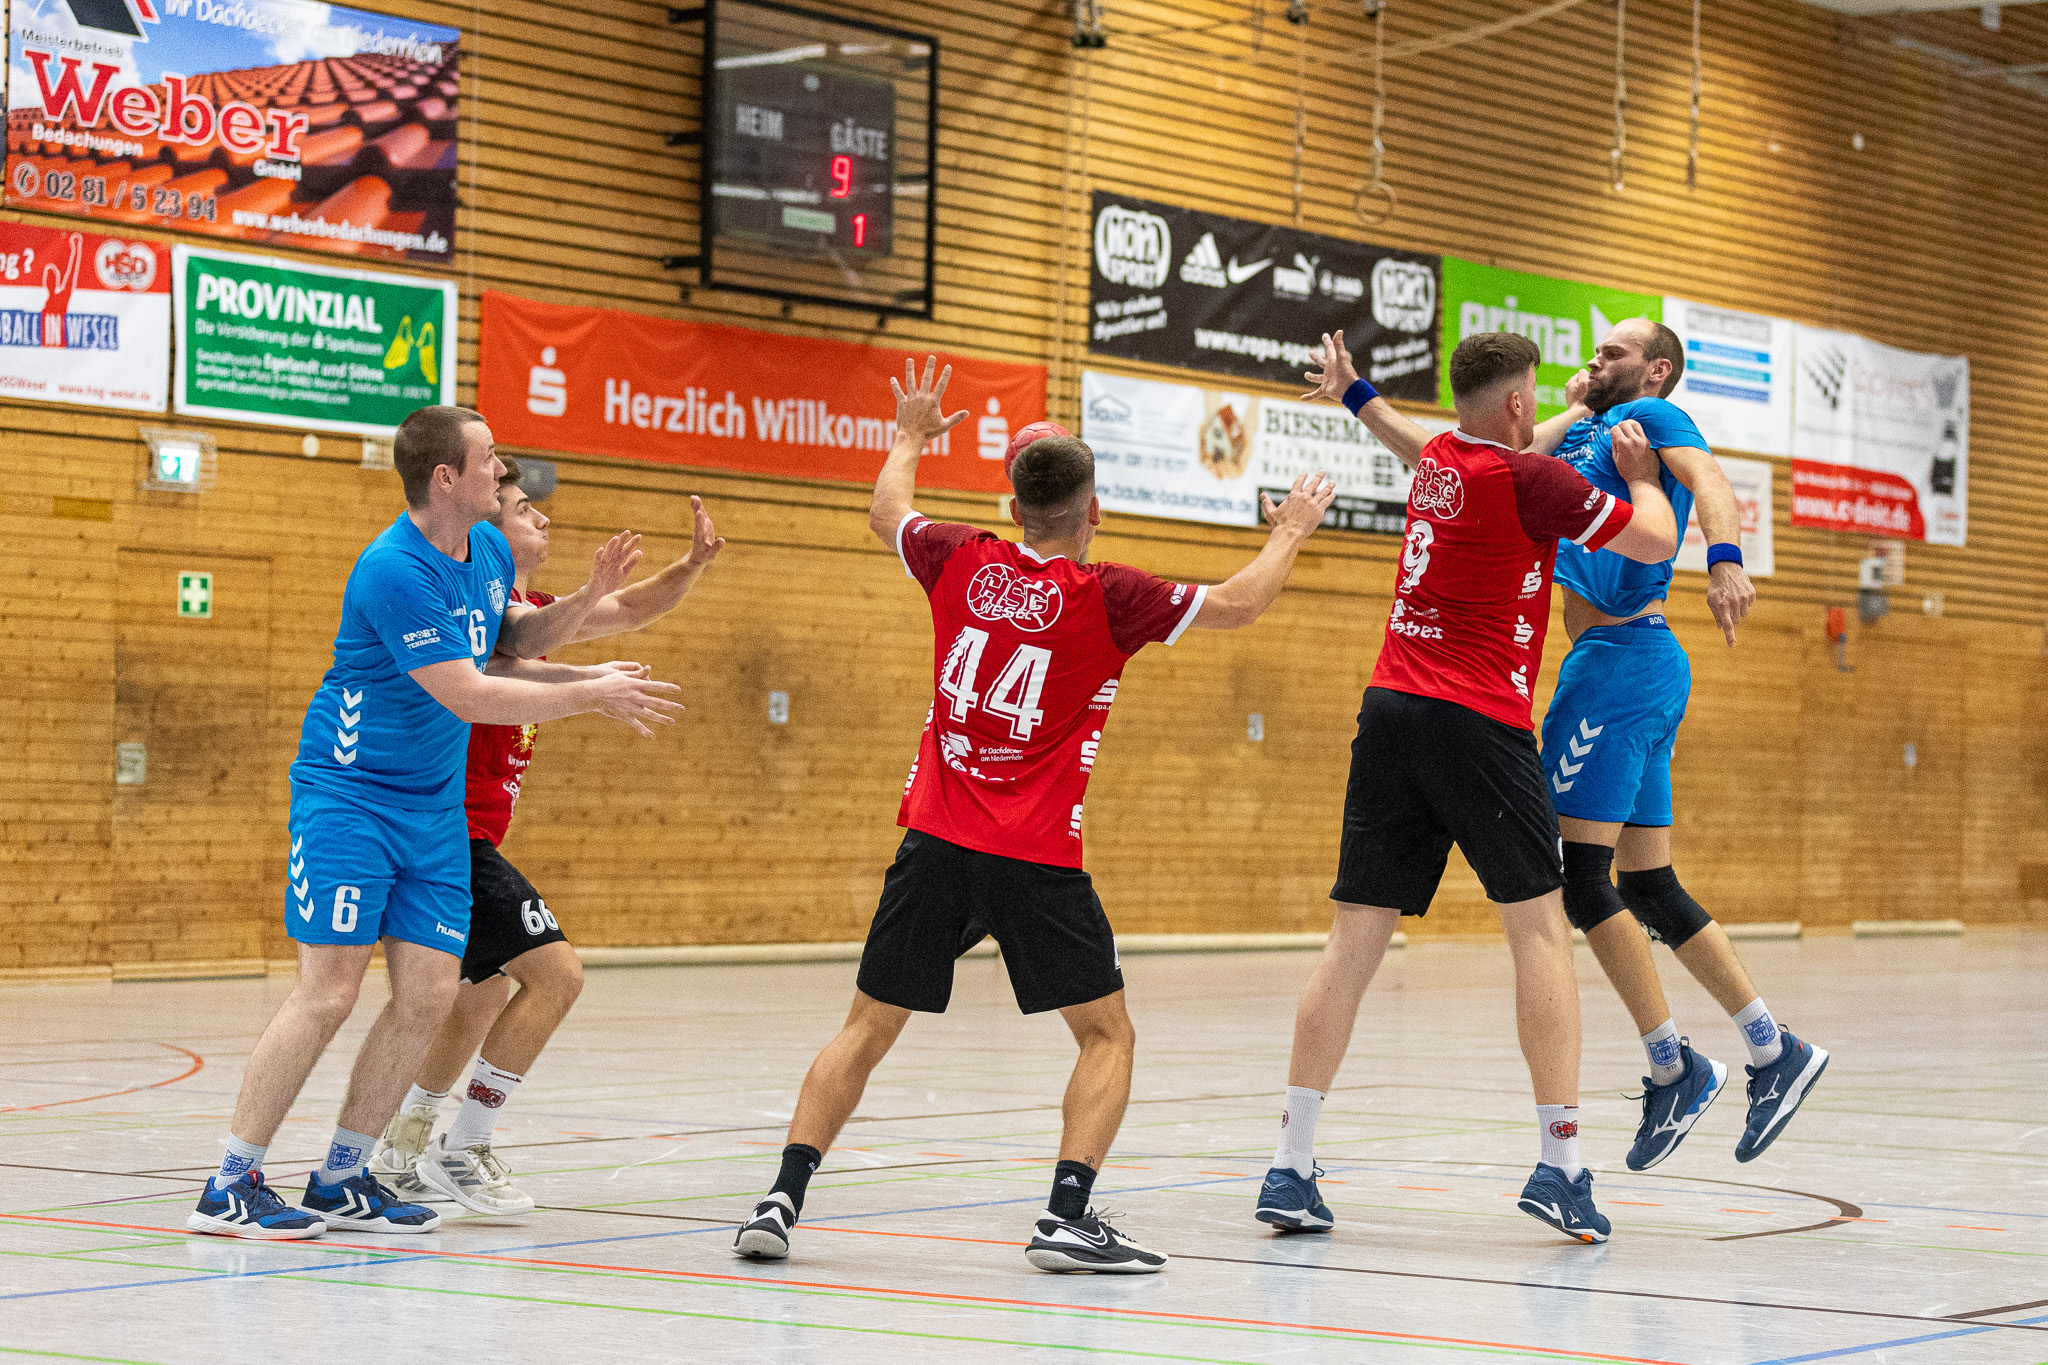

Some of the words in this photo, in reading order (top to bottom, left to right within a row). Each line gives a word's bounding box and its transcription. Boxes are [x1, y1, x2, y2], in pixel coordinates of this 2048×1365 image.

[22, 28, 124, 58] Meisterbetrieb
[23, 48, 308, 160] Weber
[736, 104, 783, 141] HEIM
[33, 123, 144, 156] Bedachungen
[830, 117, 887, 160] GÄSTE
[253, 158, 302, 181] GmbH
[830, 155, 852, 198] 9
[45, 170, 76, 200] 02
[81, 175, 108, 206] 81
[131, 183, 147, 210] 5
[153, 186, 181, 217] 23
[187, 193, 217, 221] 94
[232, 210, 448, 253] www.weberbedachungen.de
[852, 213, 866, 247] 1
[195, 272, 383, 335] PROVINZIAL
[0, 311, 40, 346] BALL
[45, 313, 62, 345] IN
[66, 315, 117, 349] WESEL
[195, 318, 215, 336] Die
[217, 321, 289, 348] Versicherung
[604, 376, 746, 440] Herzlich
[753, 396, 950, 457] Willkomn
[1416, 493, 1449, 509] WESEL
[1399, 519, 1435, 594] 9
[978, 576, 1048, 614] HSG
[981, 600, 1032, 621] WESEL
[402, 627, 438, 643] SPORT
[468, 608, 487, 656] 6
[938, 624, 1052, 742] 44
[1088, 703, 1111, 711] nispa.
[331, 885, 361, 933] 6
[521, 898, 560, 936] 66
[436, 922, 465, 942] hummel
